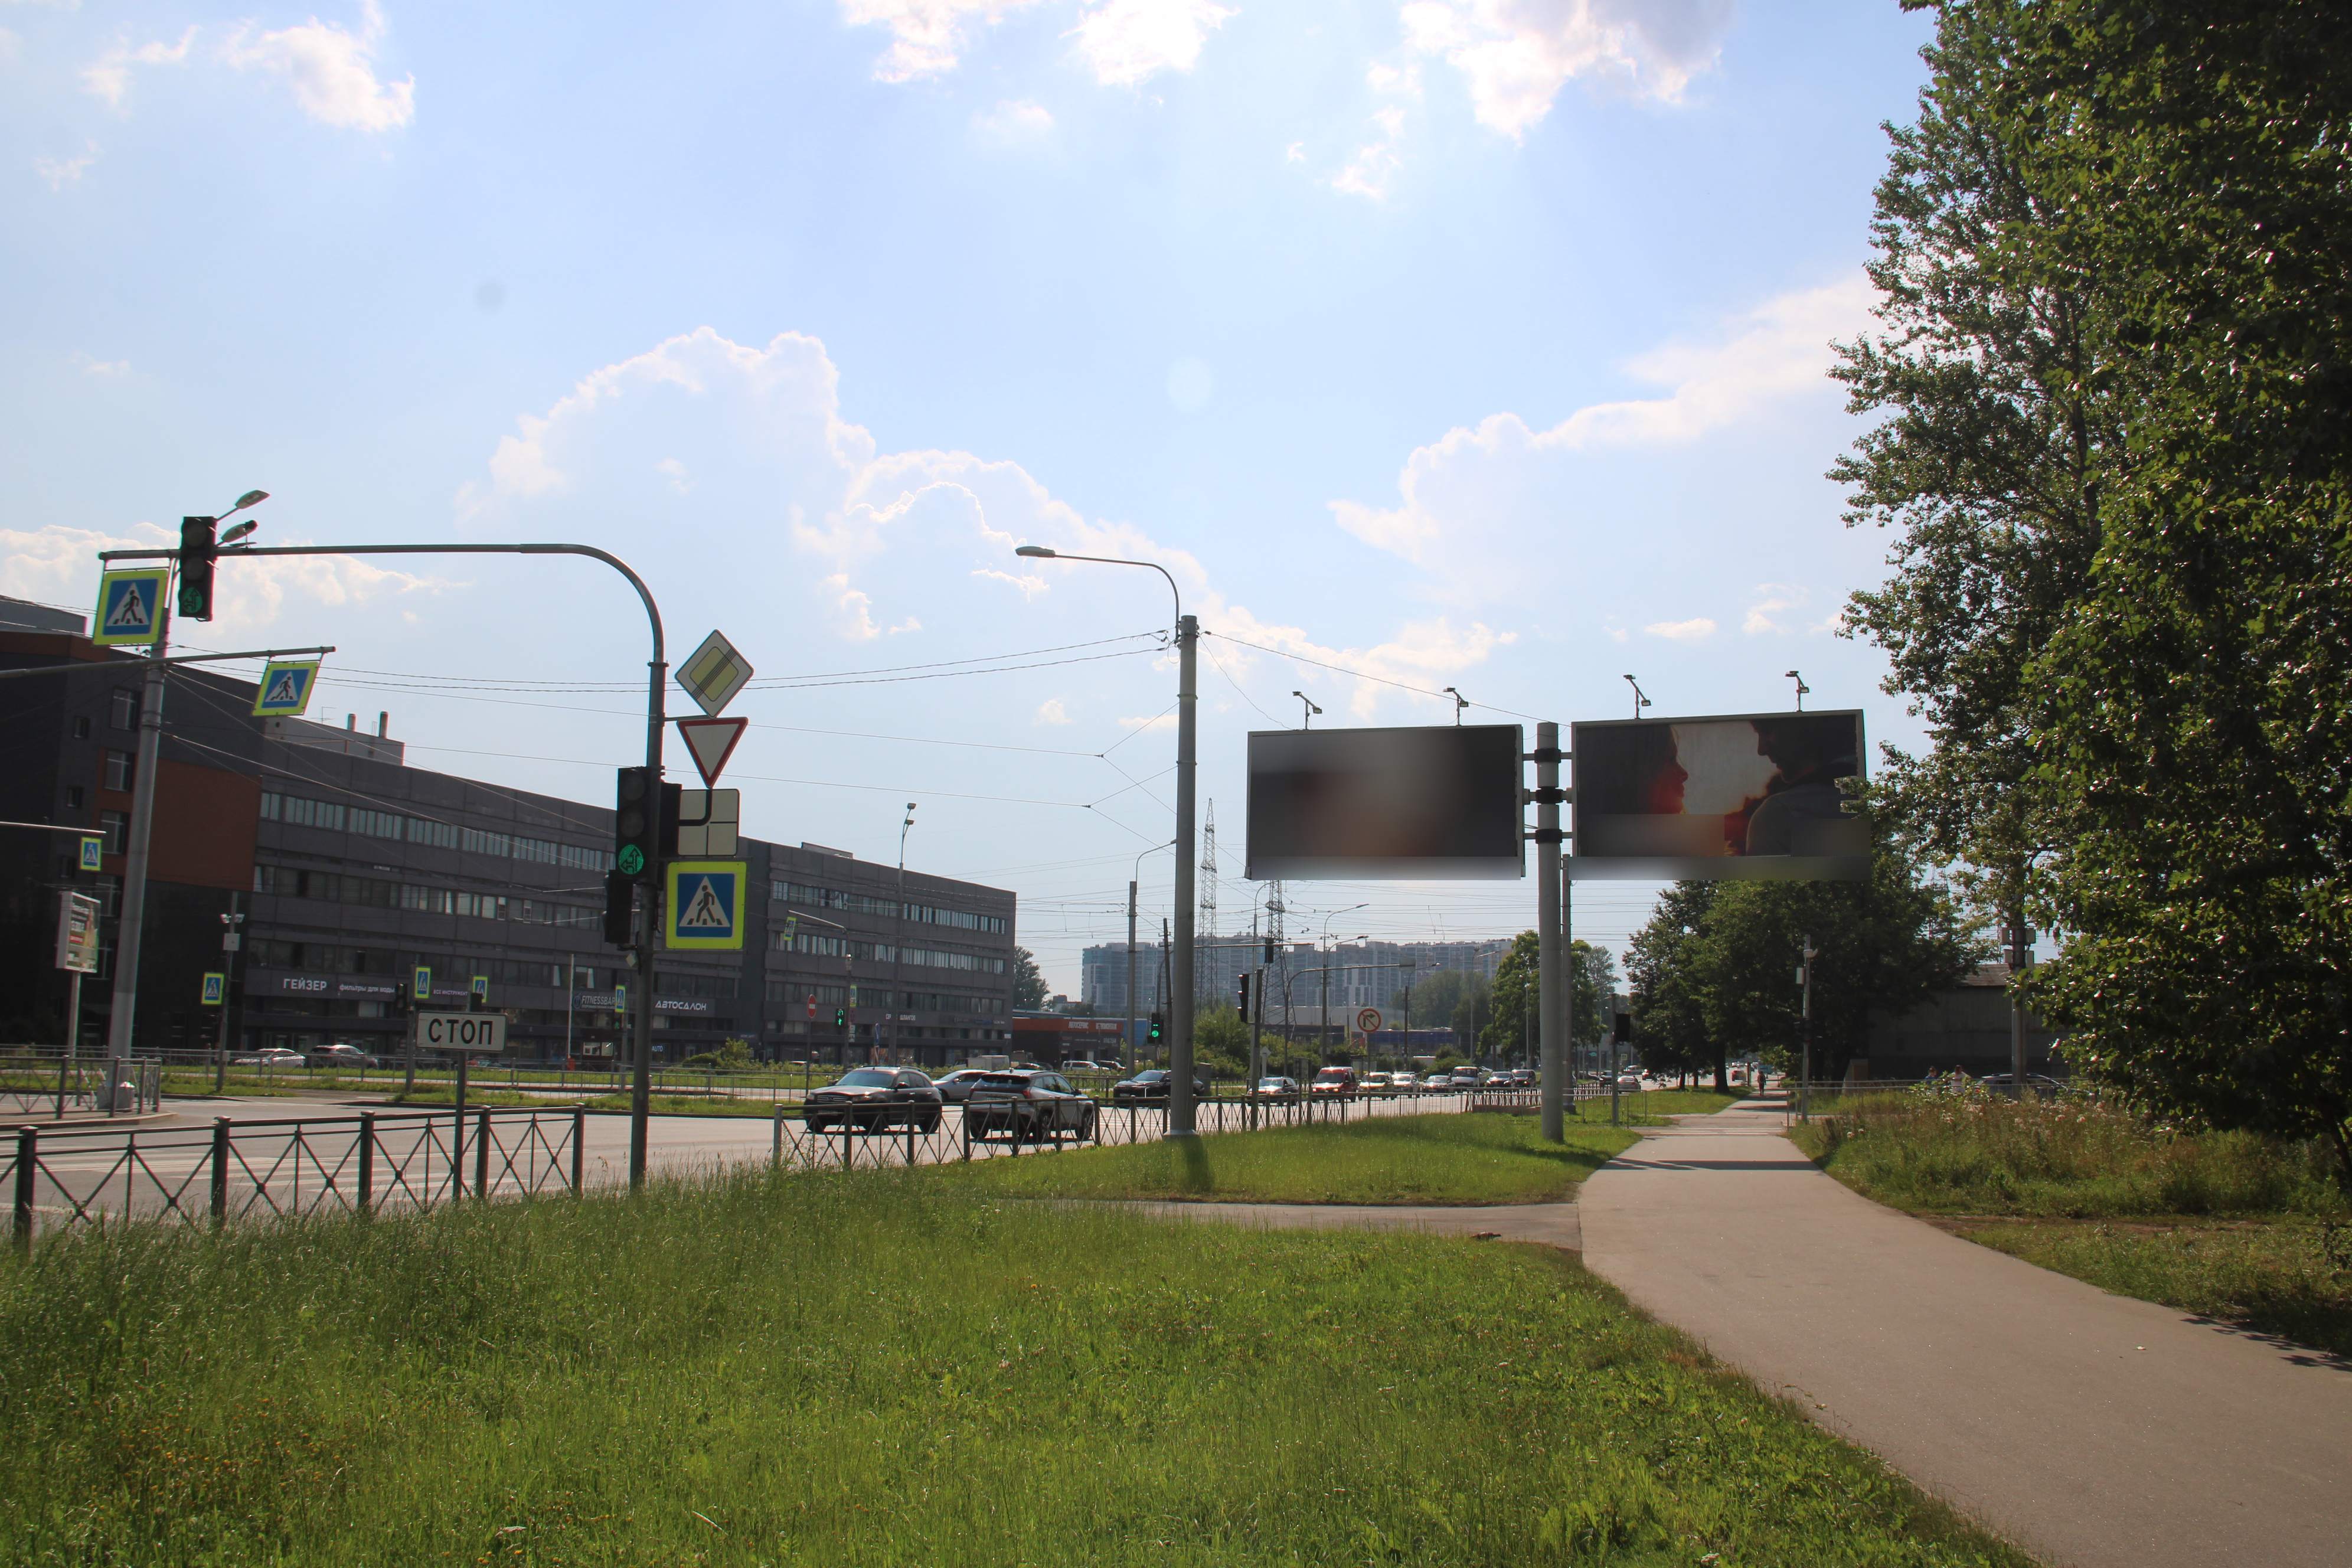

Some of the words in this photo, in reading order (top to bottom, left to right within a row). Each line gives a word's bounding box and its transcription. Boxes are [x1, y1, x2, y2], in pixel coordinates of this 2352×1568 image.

[283, 977, 327, 991] ГЕЙЗЕР
[339, 983, 366, 992] фильтры
[582, 995, 616, 1005] FITNESSBAR
[655, 1000, 707, 1011] АВТОСАЛОН
[428, 1018, 493, 1045] СТОП
